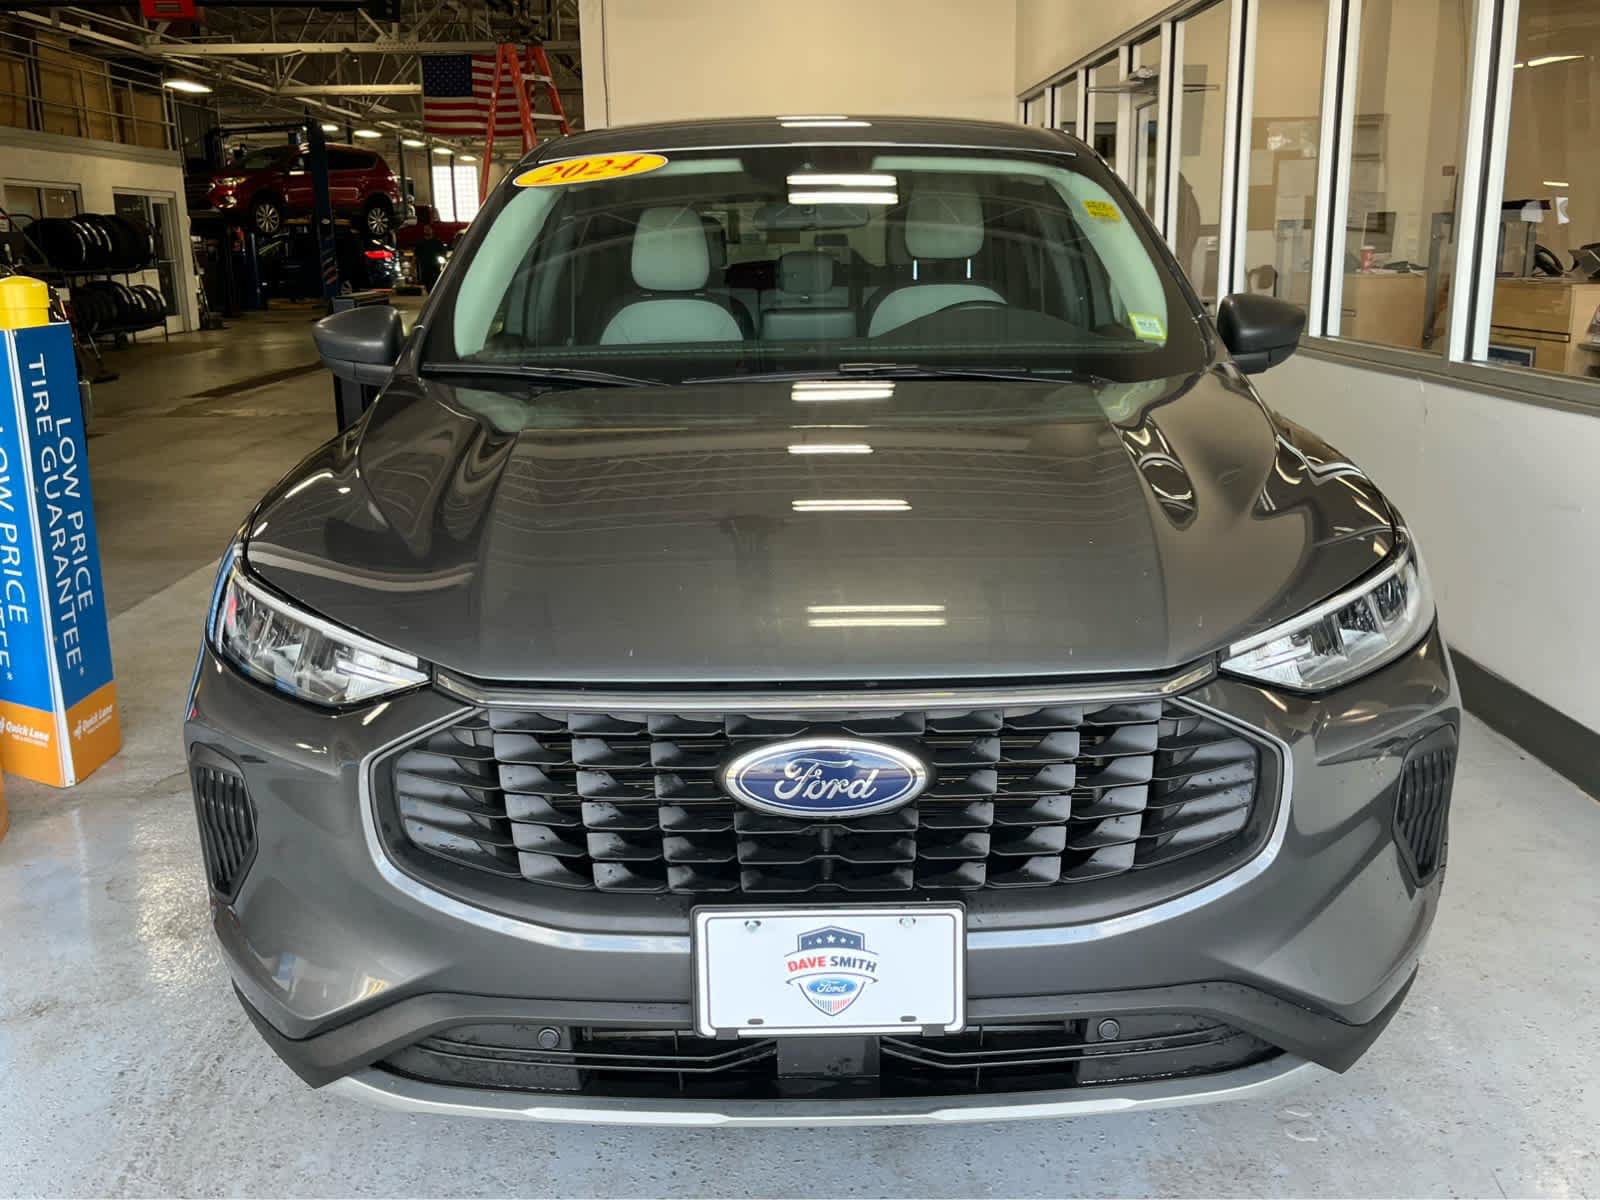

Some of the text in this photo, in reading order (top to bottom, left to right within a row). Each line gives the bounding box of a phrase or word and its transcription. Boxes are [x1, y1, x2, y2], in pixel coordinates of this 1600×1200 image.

[534, 156, 645, 183] 2024
[29, 353, 53, 436] TIRE
[56, 417, 94, 611] LOW PRICE
[0, 522, 28, 624] PRICE
[6, 721, 29, 738] Quick
[29, 727, 49, 742] Lane
[774, 758, 880, 800] Ford
[787, 956, 877, 972] DAVE SMITH
[816, 980, 848, 993] Ford
